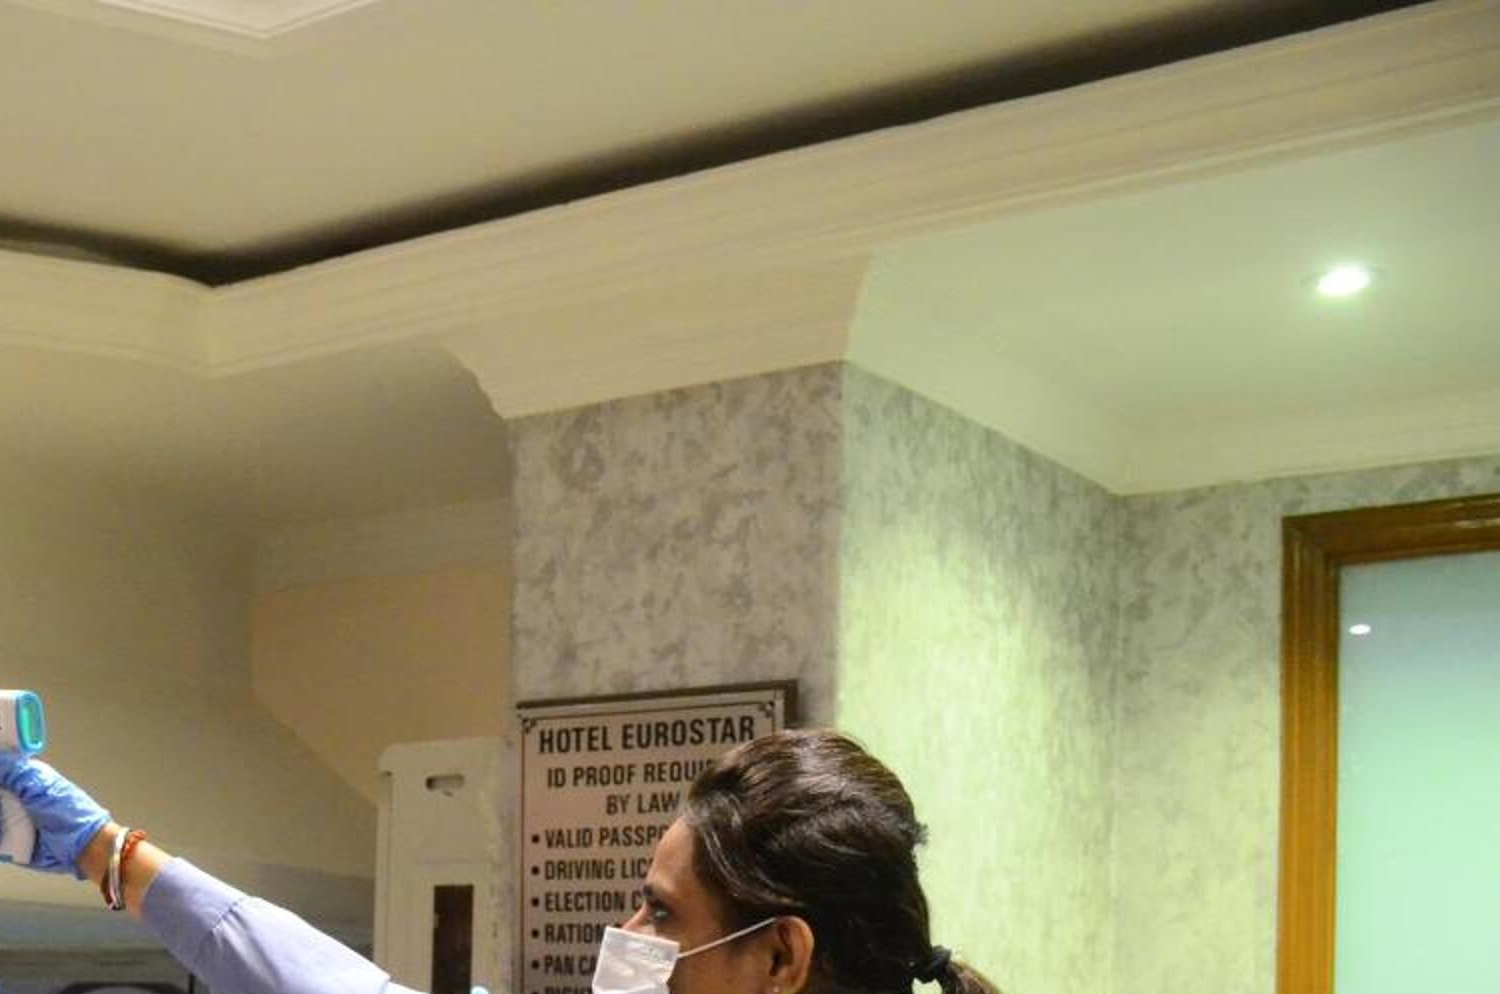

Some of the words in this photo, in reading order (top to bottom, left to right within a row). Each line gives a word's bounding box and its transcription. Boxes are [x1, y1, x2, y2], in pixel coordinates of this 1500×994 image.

[539, 726, 612, 754] HOTEL
[622, 715, 755, 749] EUROSTAR
[547, 767, 566, 789] ID
[573, 763, 637, 787] PROOF
[606, 794, 630, 815] BY
[637, 791, 681, 814] LAW
[544, 828, 592, 849] VALID
[544, 859, 615, 880] DRIVING
[621, 857, 652, 879] LIC
[544, 890, 625, 912] ELECTION
[544, 923, 602, 944] RATION
[544, 955, 575, 975] PAN
